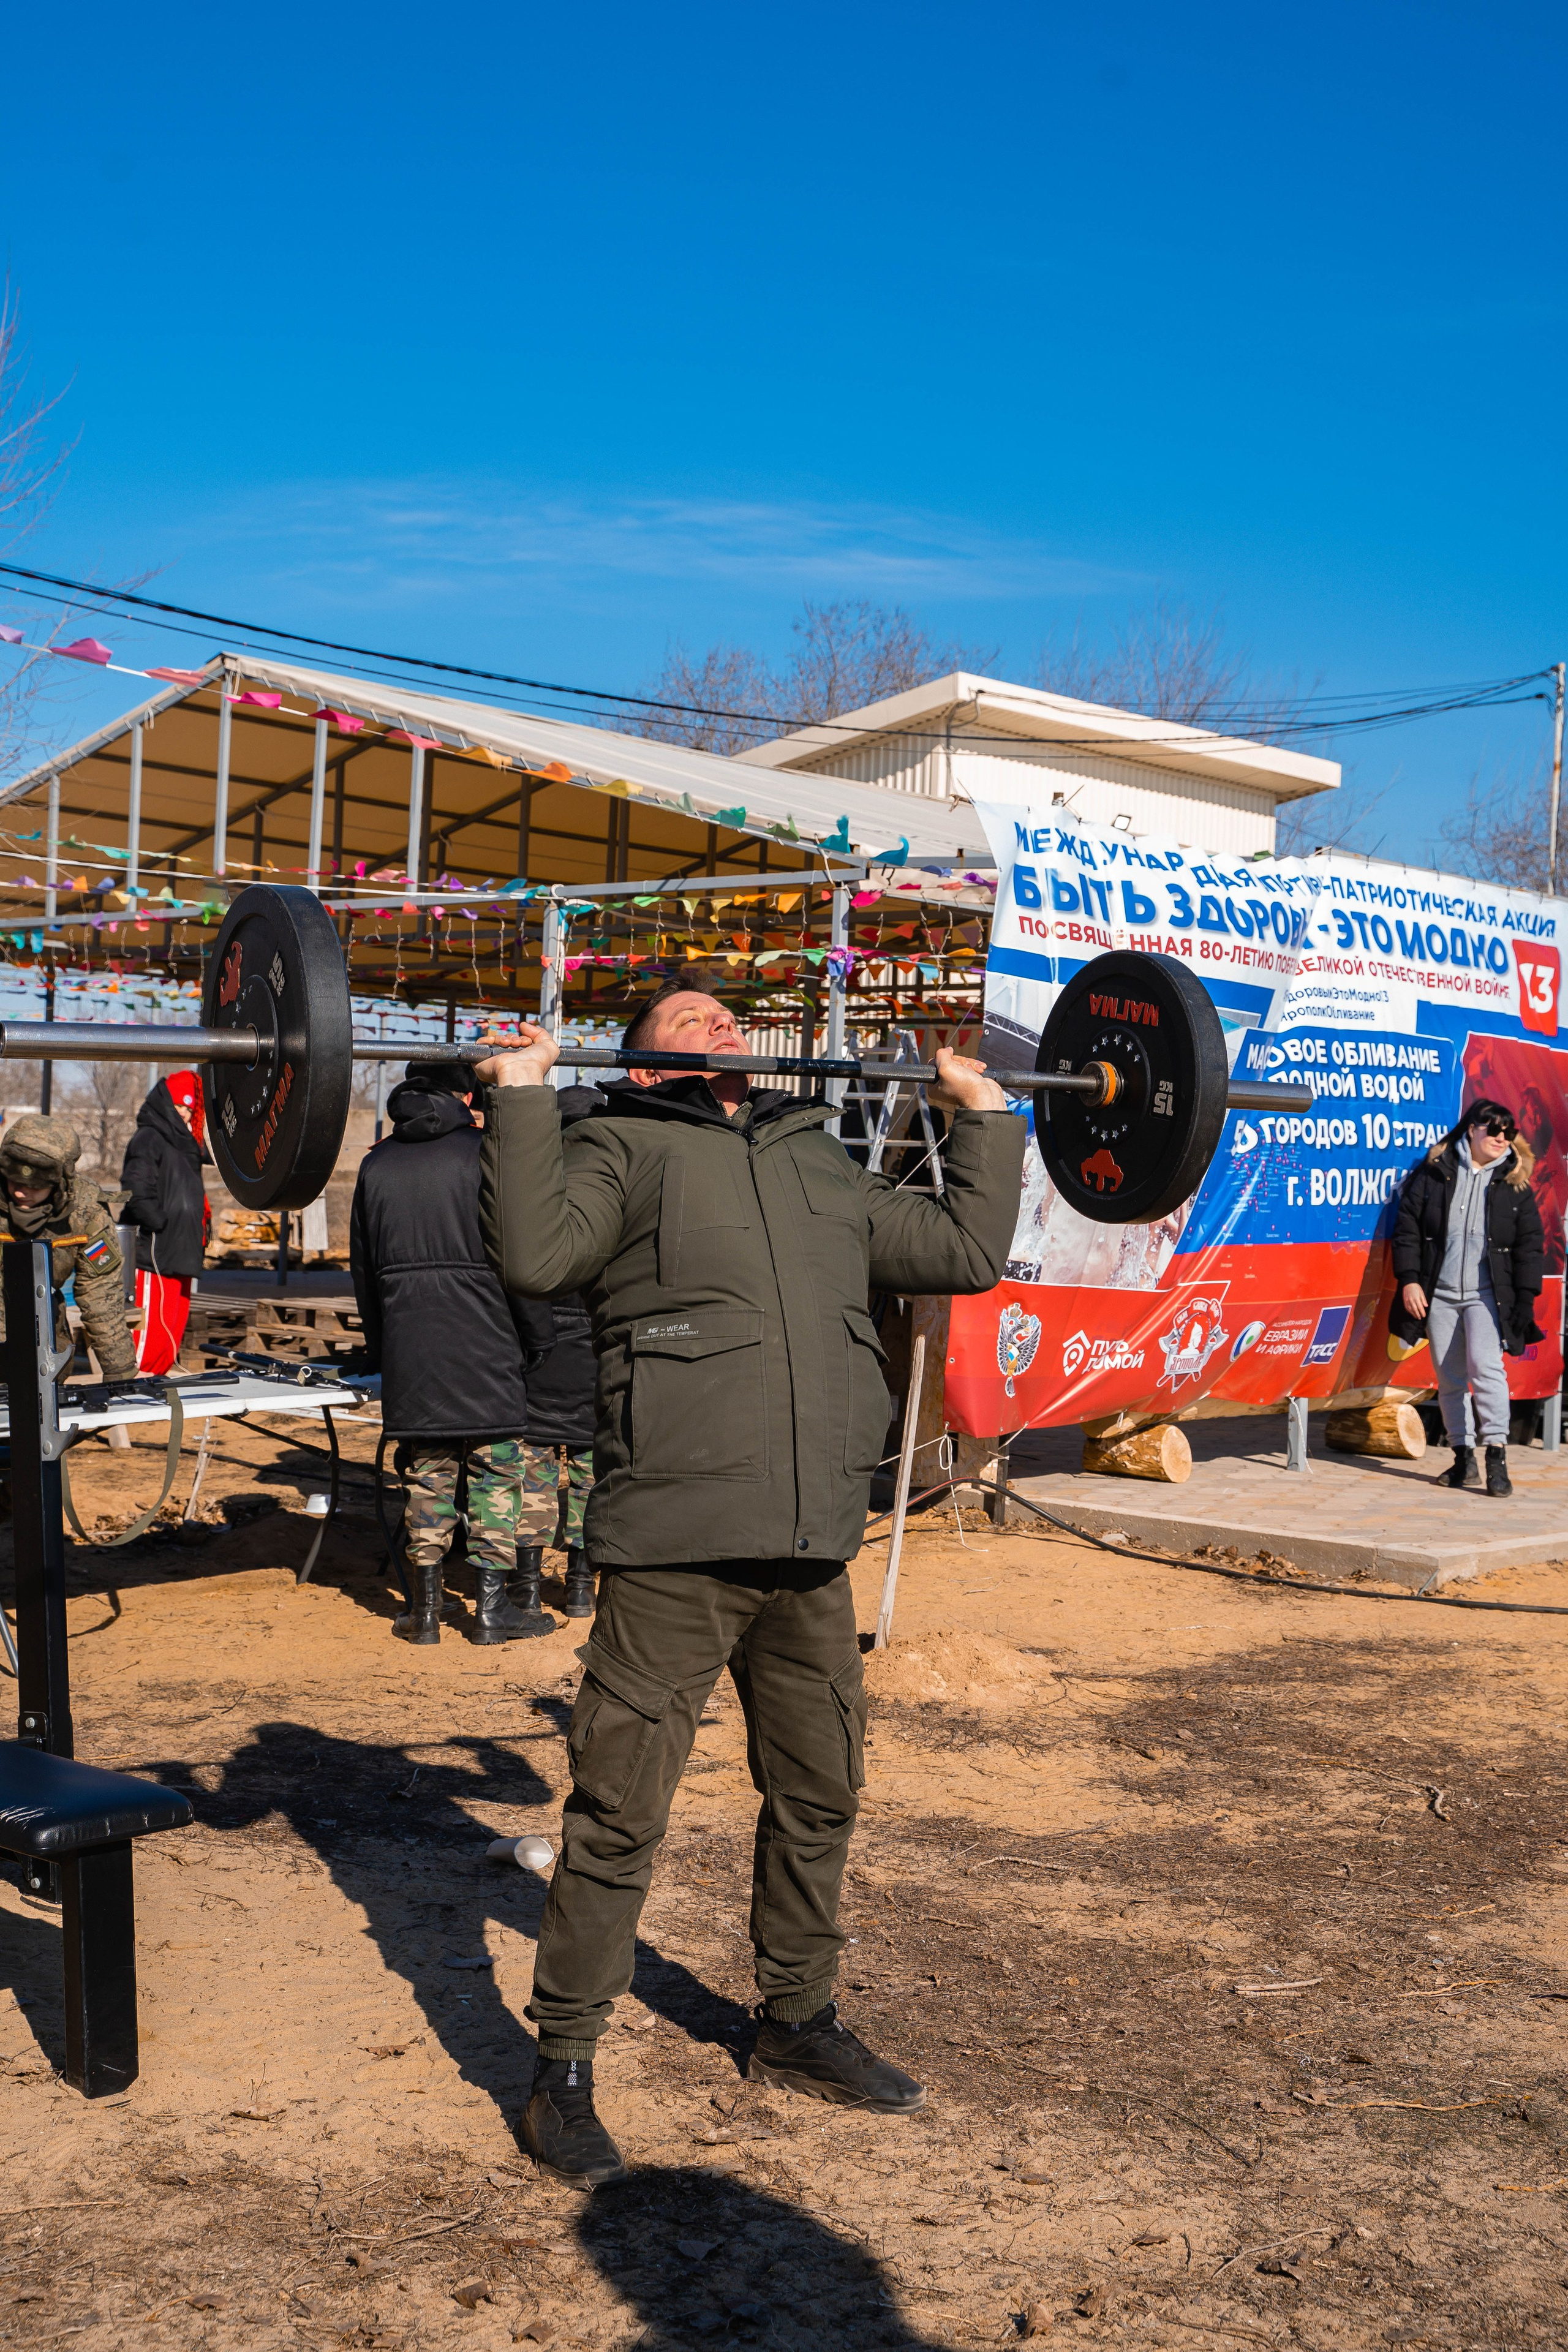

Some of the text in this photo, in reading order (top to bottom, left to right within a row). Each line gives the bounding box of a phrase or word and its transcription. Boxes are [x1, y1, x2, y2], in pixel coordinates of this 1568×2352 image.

[1013, 864, 1156, 924] БЫТЬ
[1332, 908, 1393, 954] ЭТО
[1395, 920, 1509, 974] МОДНО
[1502, 909, 1556, 938] АКЦИЯ
[269, 951, 282, 989] 15
[1200, 940, 1274, 971] 80-ЛЕТИЮ
[1370, 961, 1472, 993] ОТЕЧЕСВЕННОЙ
[1089, 992, 1160, 1027] МАГМА
[1331, 1041, 1441, 1073] ОБЛИВАНИЕ
[1159, 1080, 1174, 1093] KG
[1360, 1072, 1425, 1104] ВОДОЙ
[221, 1093, 235, 1129] 15
[254, 1062, 295, 1171] МАГМА
[1153, 1092, 1174, 1117] 15
[1259, 1117, 1358, 1150] ГОРОДОВ
[1361, 1113, 1390, 1150] 10
[666, 1323, 690, 1333] WEAR
[1263, 1329, 1310, 1342] ЕВРАЗИИ
[1255, 1343, 1268, 1354] И
